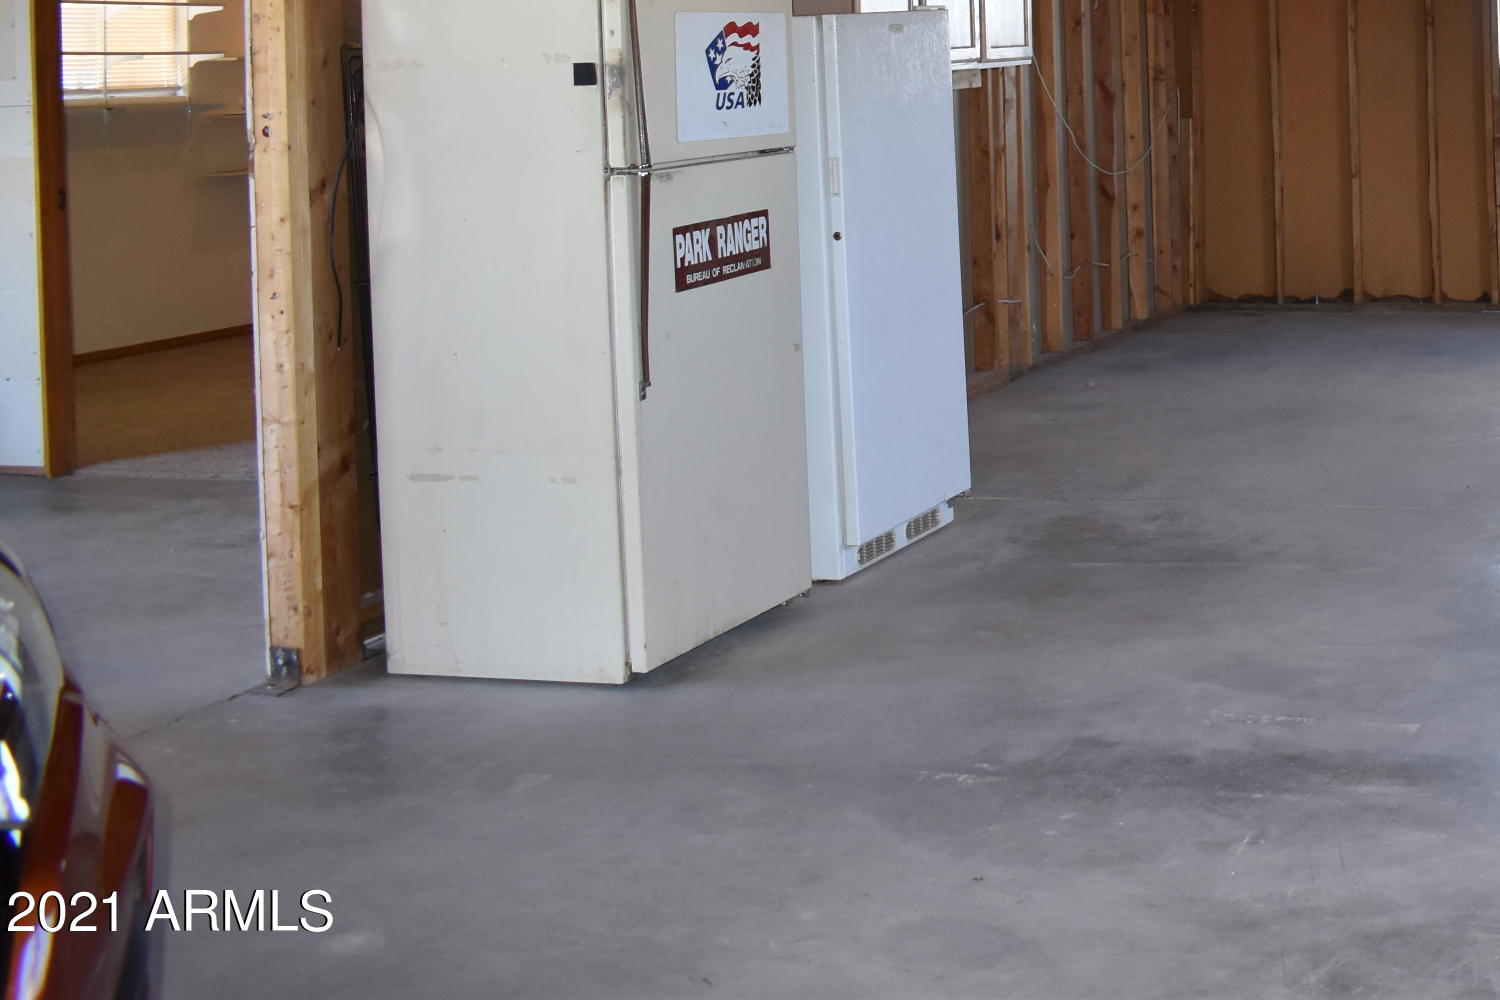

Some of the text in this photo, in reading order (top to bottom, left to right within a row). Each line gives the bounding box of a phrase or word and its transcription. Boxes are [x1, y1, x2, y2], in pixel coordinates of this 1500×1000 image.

[716, 91, 745, 111] USA
[675, 216, 768, 268] PARK RANGER
[686, 270, 711, 284] BUREAU
[712, 267, 720, 277] OF
